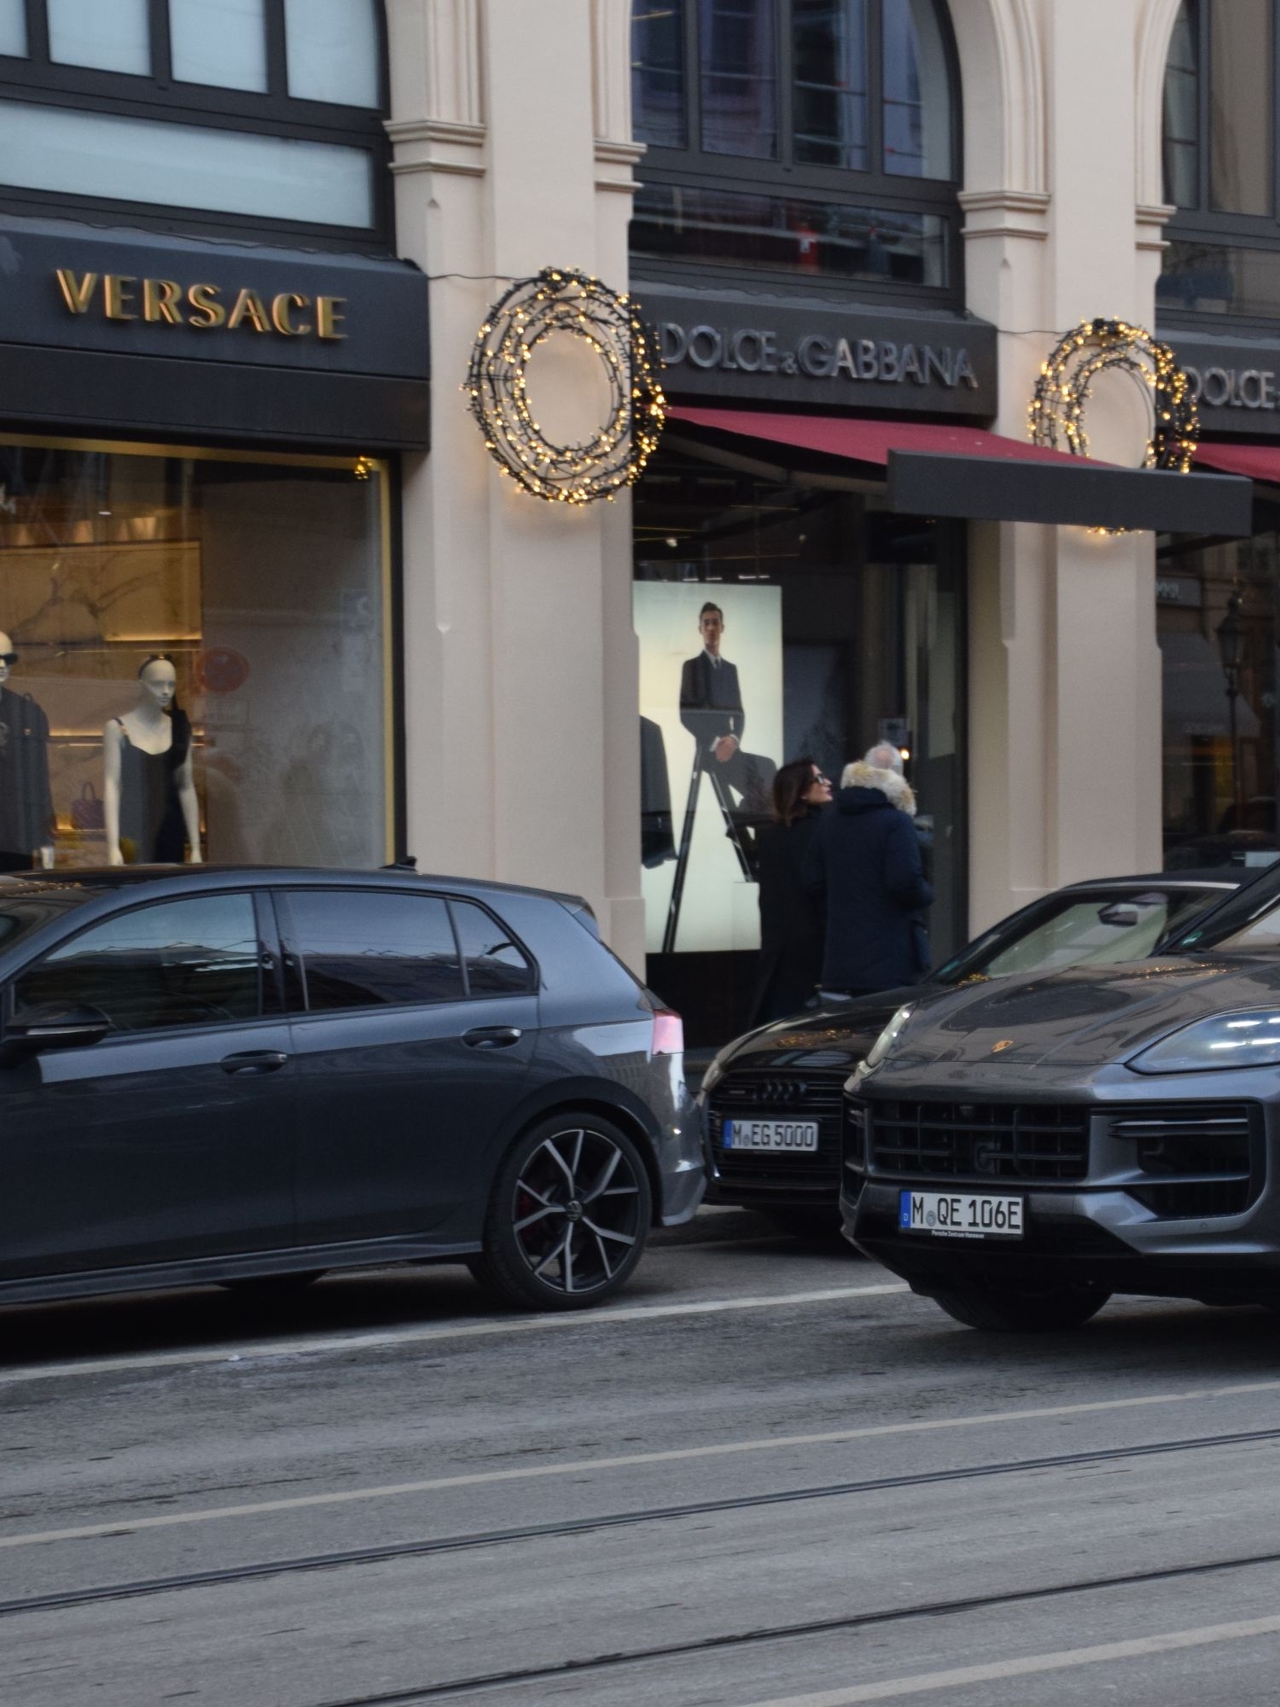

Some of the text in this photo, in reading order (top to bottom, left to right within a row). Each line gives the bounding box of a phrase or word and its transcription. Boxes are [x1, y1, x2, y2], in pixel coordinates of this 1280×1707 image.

[56, 269, 349, 339] VERSACE
[732, 1123, 814, 1148] M EG 5000
[912, 1196, 1021, 1229] M QE 106E
